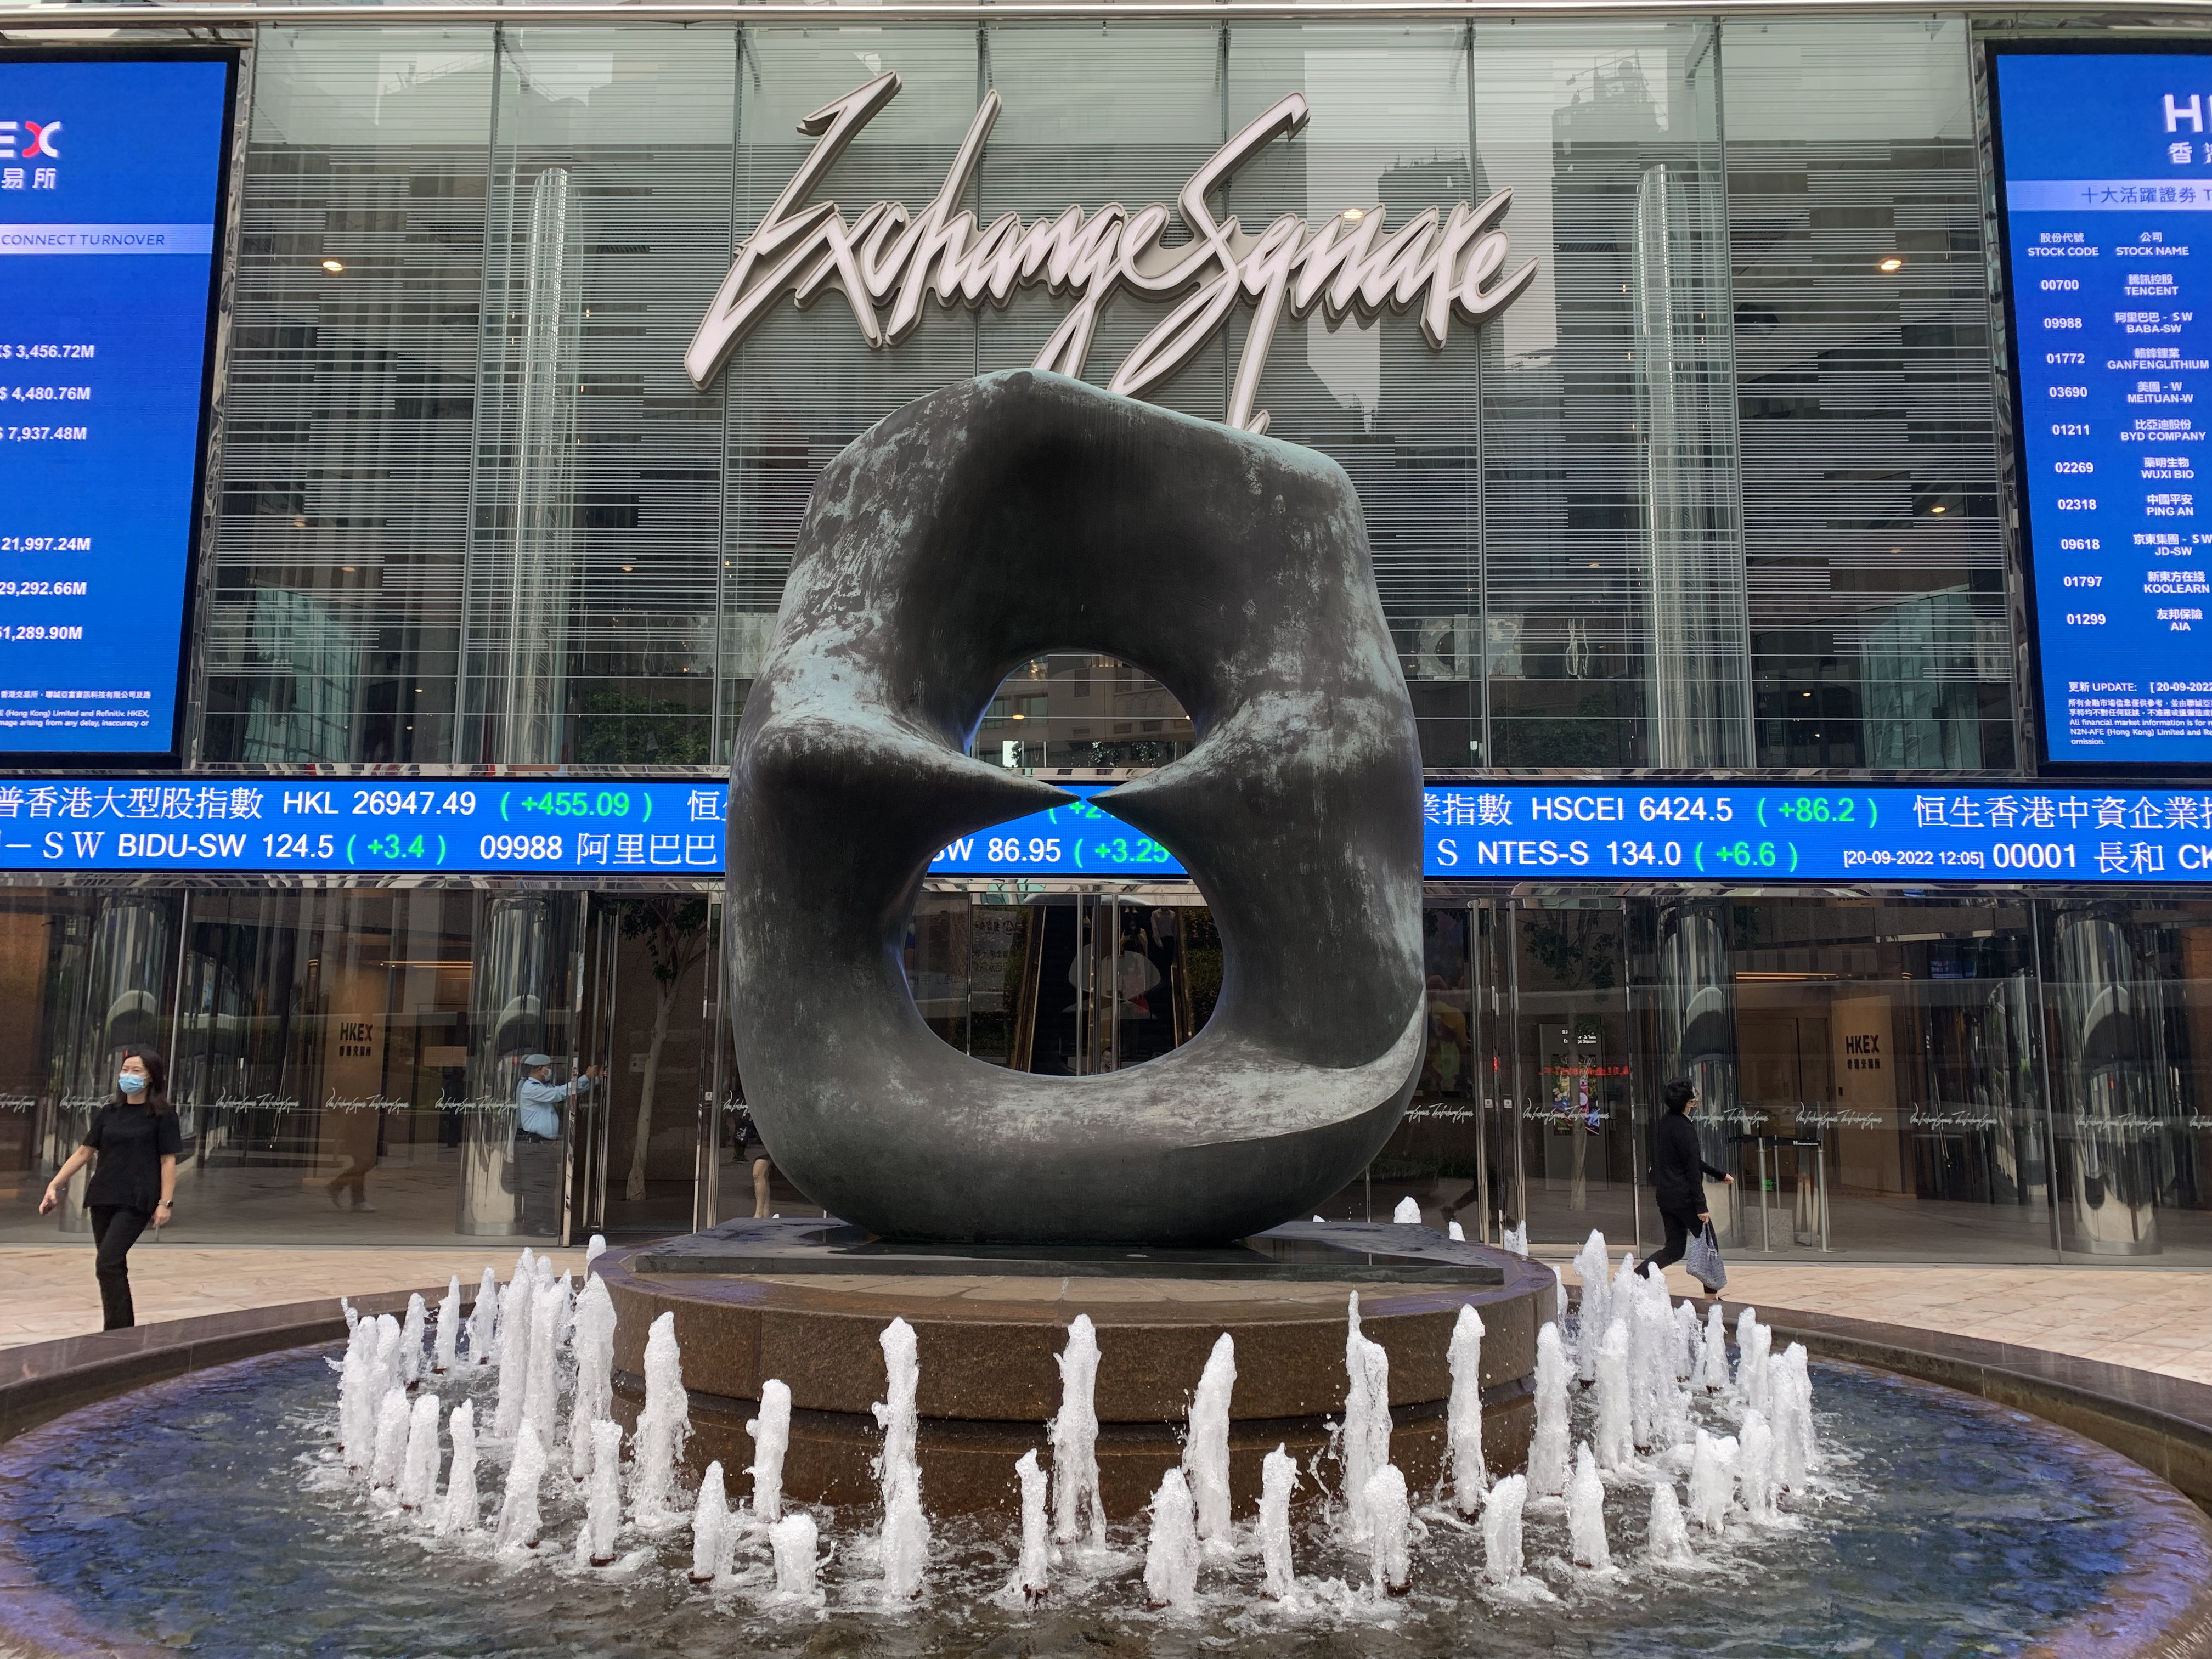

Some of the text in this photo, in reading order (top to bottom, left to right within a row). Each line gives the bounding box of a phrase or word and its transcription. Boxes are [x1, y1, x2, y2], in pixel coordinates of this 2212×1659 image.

[2164, 94, 2212, 132] H
[1, 168, 56, 189] 易所
[1, 233, 166, 247] CONNECT TURNOVER
[2041, 232, 2162, 242] 股份代號 公司
[684, 70, 1541, 435] Exchange Square
[2028, 247, 2189, 256] STOCK CODE STOCK NAME
[2041, 280, 2179, 295] 00700 TENCENT
[2044, 318, 2181, 333] 09988 BABA-SW
[2115, 312, 2160, 323] 阿里巴巴
[16, 345, 94, 359] 3,456.72M
[2047, 353, 2209, 369] 01772 GANFENGLITHIUM
[12, 387, 91, 402] 4,480.76M
[2050, 387, 2193, 403] 03690 MEITUAN-W
[2136, 419, 2191, 430] 比亞迪股份
[8, 427, 87, 442] 7,937.48M
[2052, 425, 2206, 441] 01211 BYD COMPANY
[2055, 462, 2194, 478] 02269 WUXI BIO
[2058, 499, 2193, 516] 02318 PING AN
[2147, 494, 2192, 505] 中國平安
[1, 538, 91, 552] 21,997.24M
[2061, 539, 2192, 555] 09618 JD-SW
[2134, 534, 2179, 545] 京東集團
[2064, 576, 2209, 592] 01797 KOOLEARN
[2067, 614, 2191, 630] 01299 AIA
[2157, 608, 2203, 620] 友邦保險
[2069, 682, 2090, 692] 更新
[2092, 683, 2137, 691] UPDATE:
[2107, 729, 2130, 737] (Hong
[284, 792, 338, 814] HKL
[352, 791, 476, 815] 26947.49
[687, 790, 727, 821] 恒
[1532, 797, 1624, 821] HSCEI
[1640, 797, 1733, 821] 6424.5
[119, 834, 246, 857] BIDU-SW
[263, 834, 333, 858] 124.5
[481, 835, 562, 859] 09988
[577, 833, 717, 865] 阿里巴巴
[988, 838, 1061, 862] 86.95
[1479, 841, 1589, 865] NTES-S
[1607, 841, 1681, 865] 134.0
[1844, 851, 1933, 868] [20-09-2022
[1939, 851, 1984, 868] 12:05]
[1993, 844, 2075, 868] 00001
[2094, 842, 2164, 874] 長和
[340, 1022, 373, 1041] HKEX
[1846, 1035, 1880, 1054] HKEX
